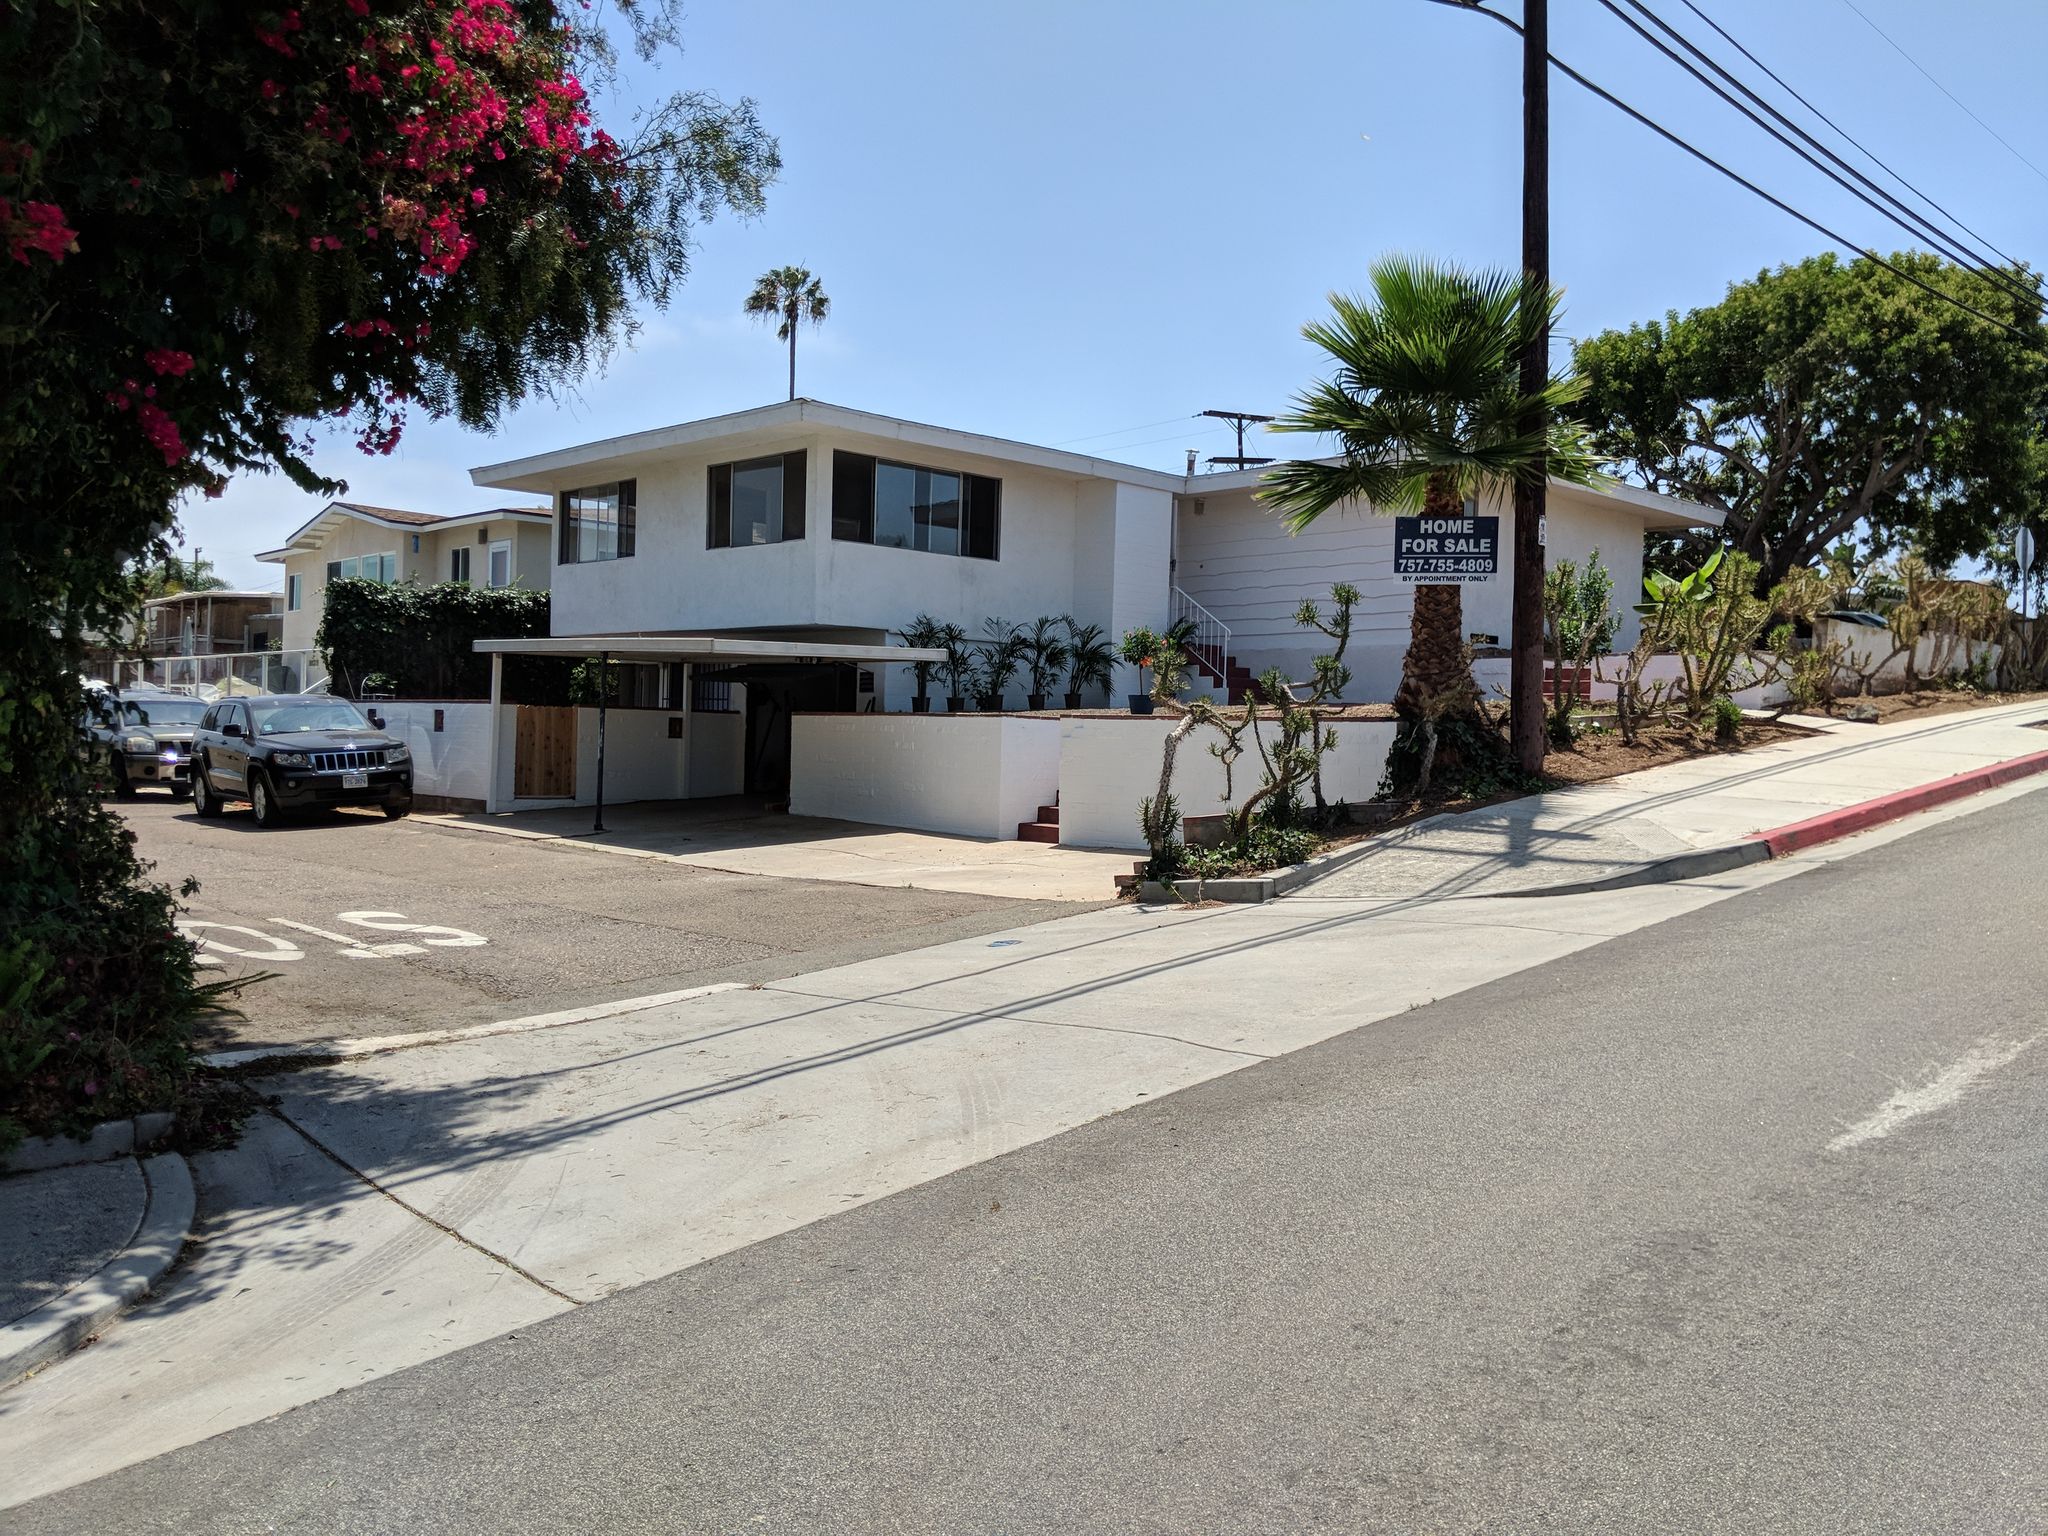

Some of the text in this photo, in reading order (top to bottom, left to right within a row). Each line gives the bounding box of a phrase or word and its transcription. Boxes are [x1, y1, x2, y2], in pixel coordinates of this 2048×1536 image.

[1420, 520, 1474, 534] HOME
[1401, 538, 1491, 553] FOR SALE
[1398, 559, 1493, 572] 757-755-4809
[173, 911, 489, 963] STO
